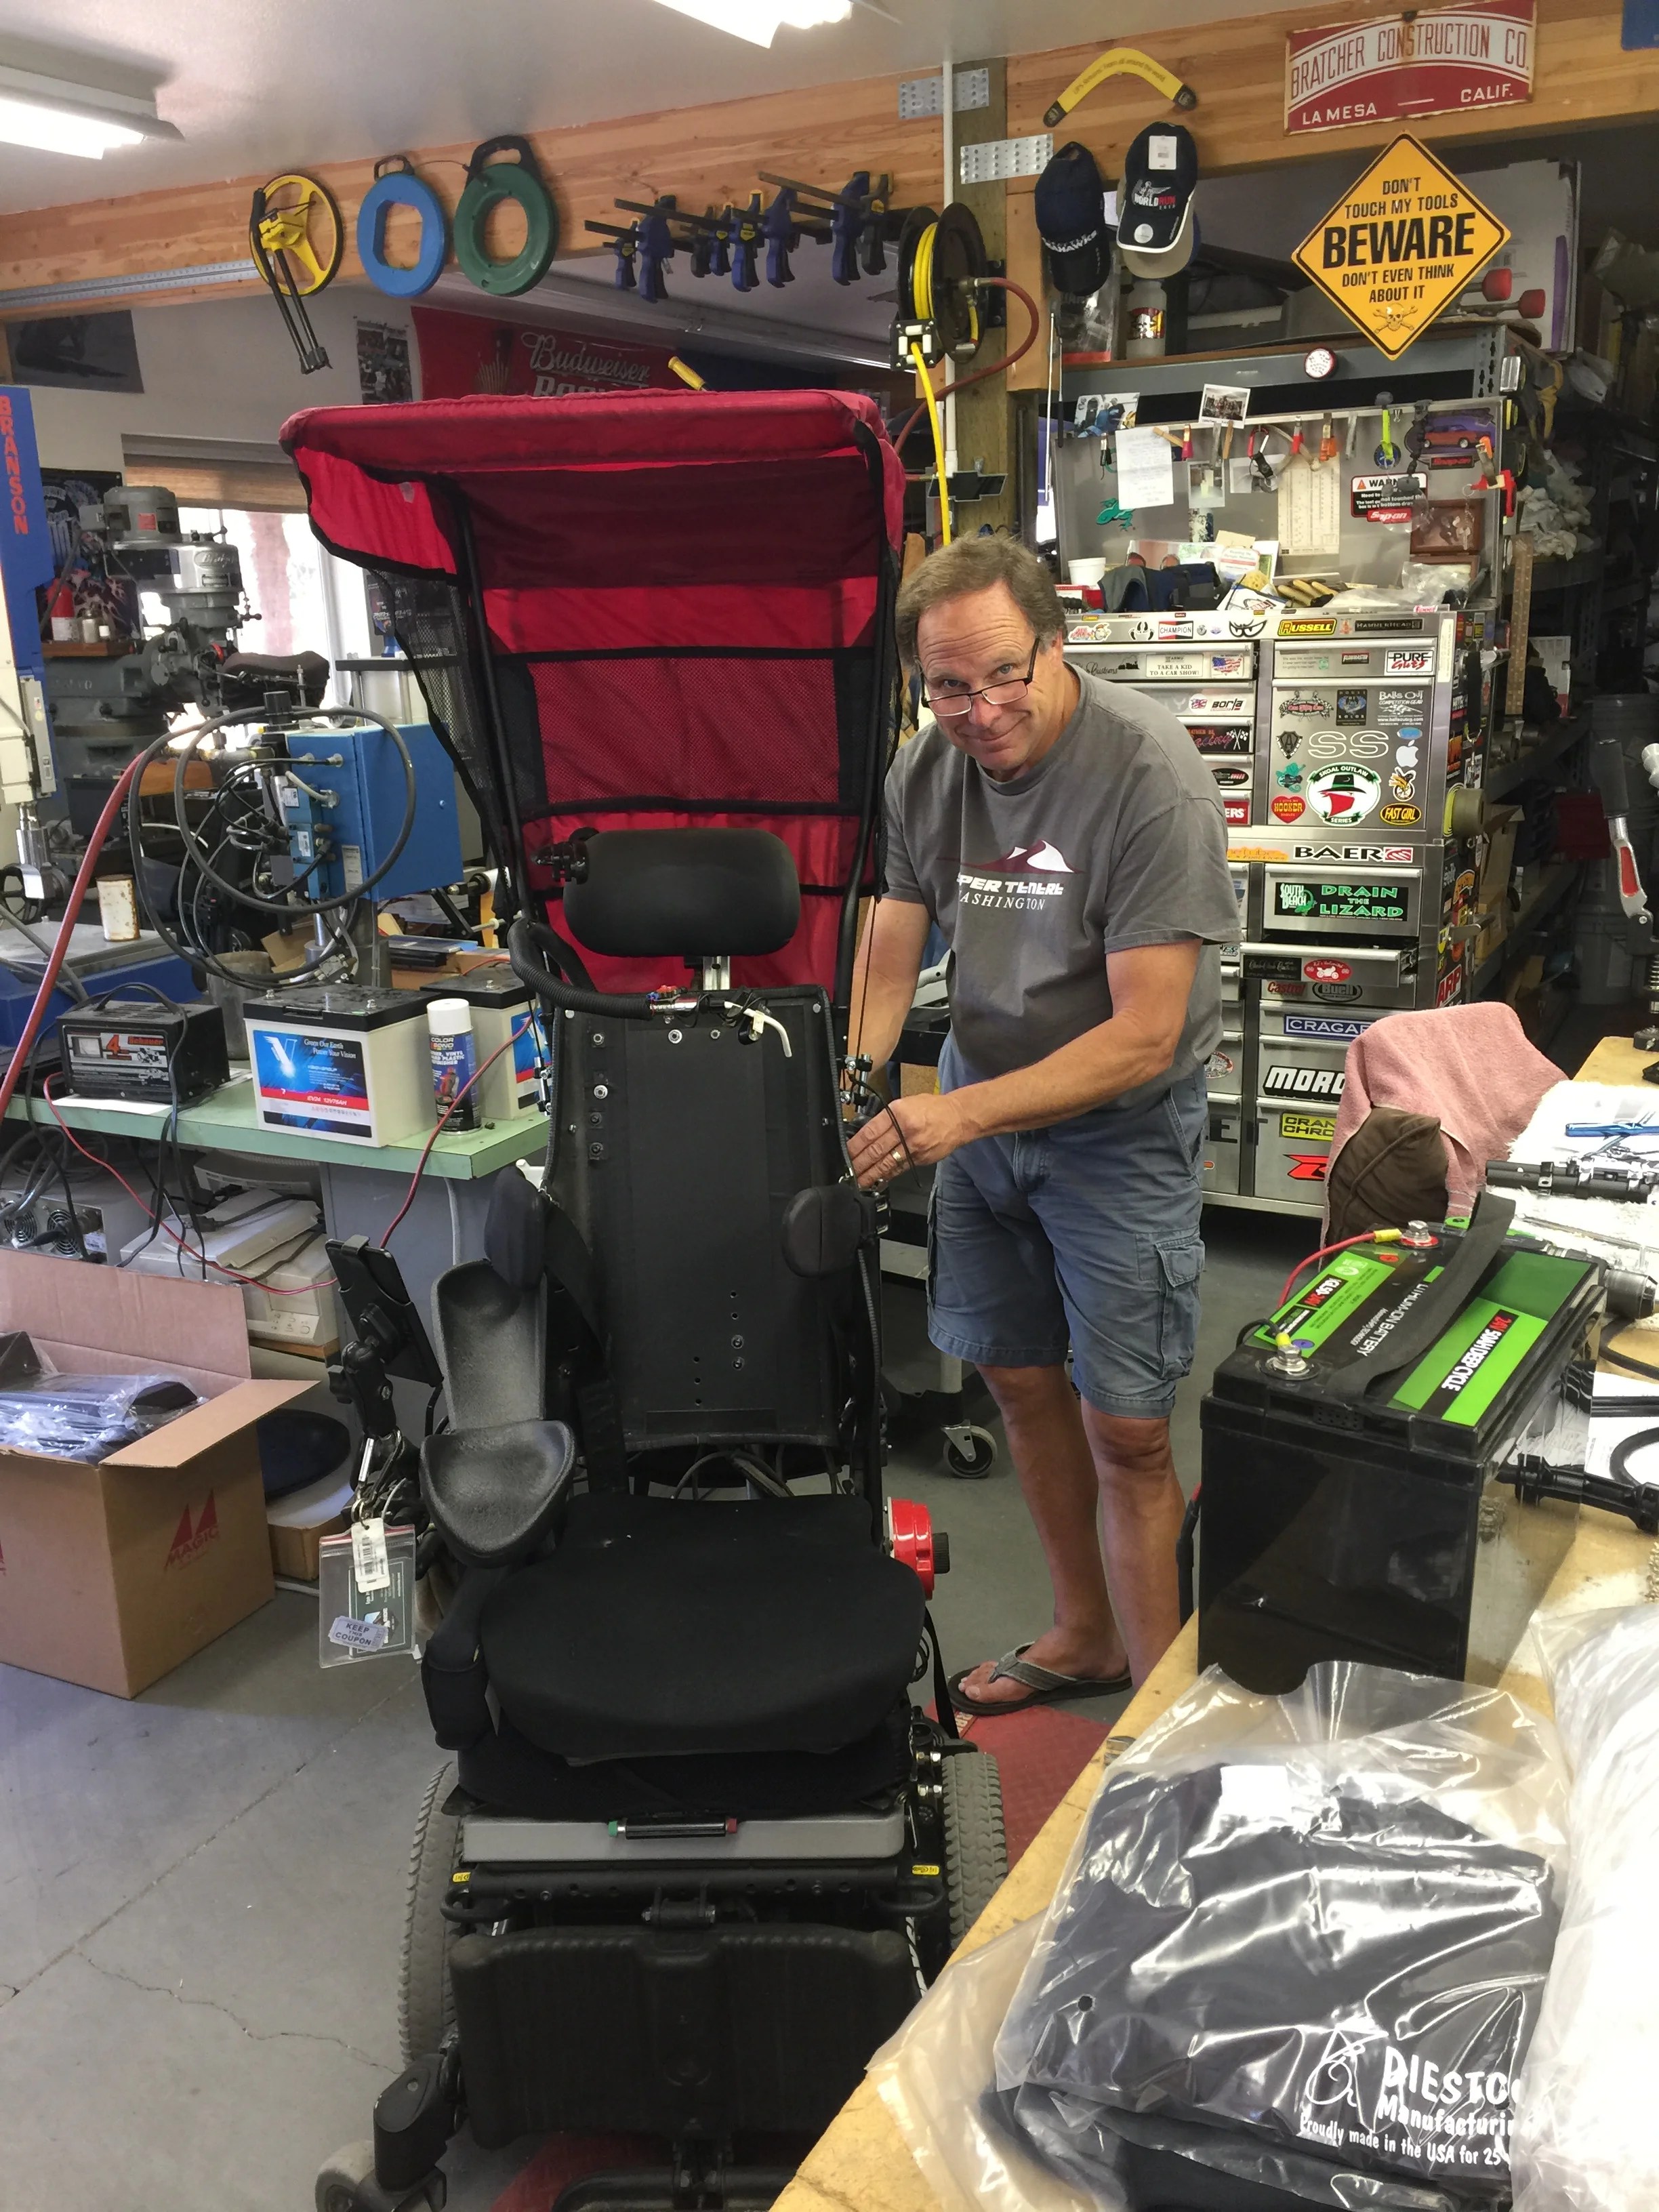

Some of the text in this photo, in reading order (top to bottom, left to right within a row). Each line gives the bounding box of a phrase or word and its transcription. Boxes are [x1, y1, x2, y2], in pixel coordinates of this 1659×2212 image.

[1291, 24, 1530, 99] BRATCHER CONSTRUCTION CO.
[1303, 84, 1514, 125] LA MESA CALIF.
[1382, 178, 1421, 195] DON'T
[1345, 194, 1458, 220] TOUCH MY TOOLS
[1322, 213, 1476, 270] BEWARE
[1342, 264, 1454, 287] DON'T EVEN THINK
[1369, 285, 1425, 303] ABOUT IT
[520, 331, 651, 380] Budweiser
[0, 395, 28, 535] BRANSON
[1160, 626, 1192, 634] CHAMPION
[1280, 621, 1333, 634] RUSSELL
[1393, 653, 1430, 661] PURE
[1308, 730, 1389, 758] SS
[1319, 766, 1369, 777] SKOAL OUTLAW
[1225, 808, 1245, 819] ERS
[1274, 803, 1303, 813] HOOKER
[1385, 808, 1416, 820] FAST GIRL
[1294, 846, 1383, 861] BAER
[956, 872, 1064, 895] PER TENERE
[1322, 885, 1398, 898] DRAIN
[958, 890, 1046, 911] ASHINGTON
[1282, 894, 1307, 909] BEACH
[1319, 904, 1404, 918] LIZARD
[1267, 981, 1307, 994] Castrol
[1322, 983, 1355, 996] Buell
[1436, 966, 1461, 1008] ARP
[106, 1034, 121, 1055] 4
[329, 1042, 344, 1050] Earth
[313, 1048, 327, 1056] Power
[340, 1050, 356, 1059] Vision
[1357, 1322, 1393, 1357] BATTERY
[1458, 1346, 1488, 1370] DEEP
[1439, 1364, 1475, 1395] CYCLE
[346, 1622, 370, 1633] KEEP
[335, 1633, 372, 1646] COUPON
[1300, 2114, 1344, 2144] Proudly
[1349, 2130, 1379, 2150] made
[1385, 2135, 1396, 2153] in
[1401, 2139, 1422, 2159] the
[1427, 2144, 1455, 2165] USA
[1459, 2147, 1479, 2165] for
